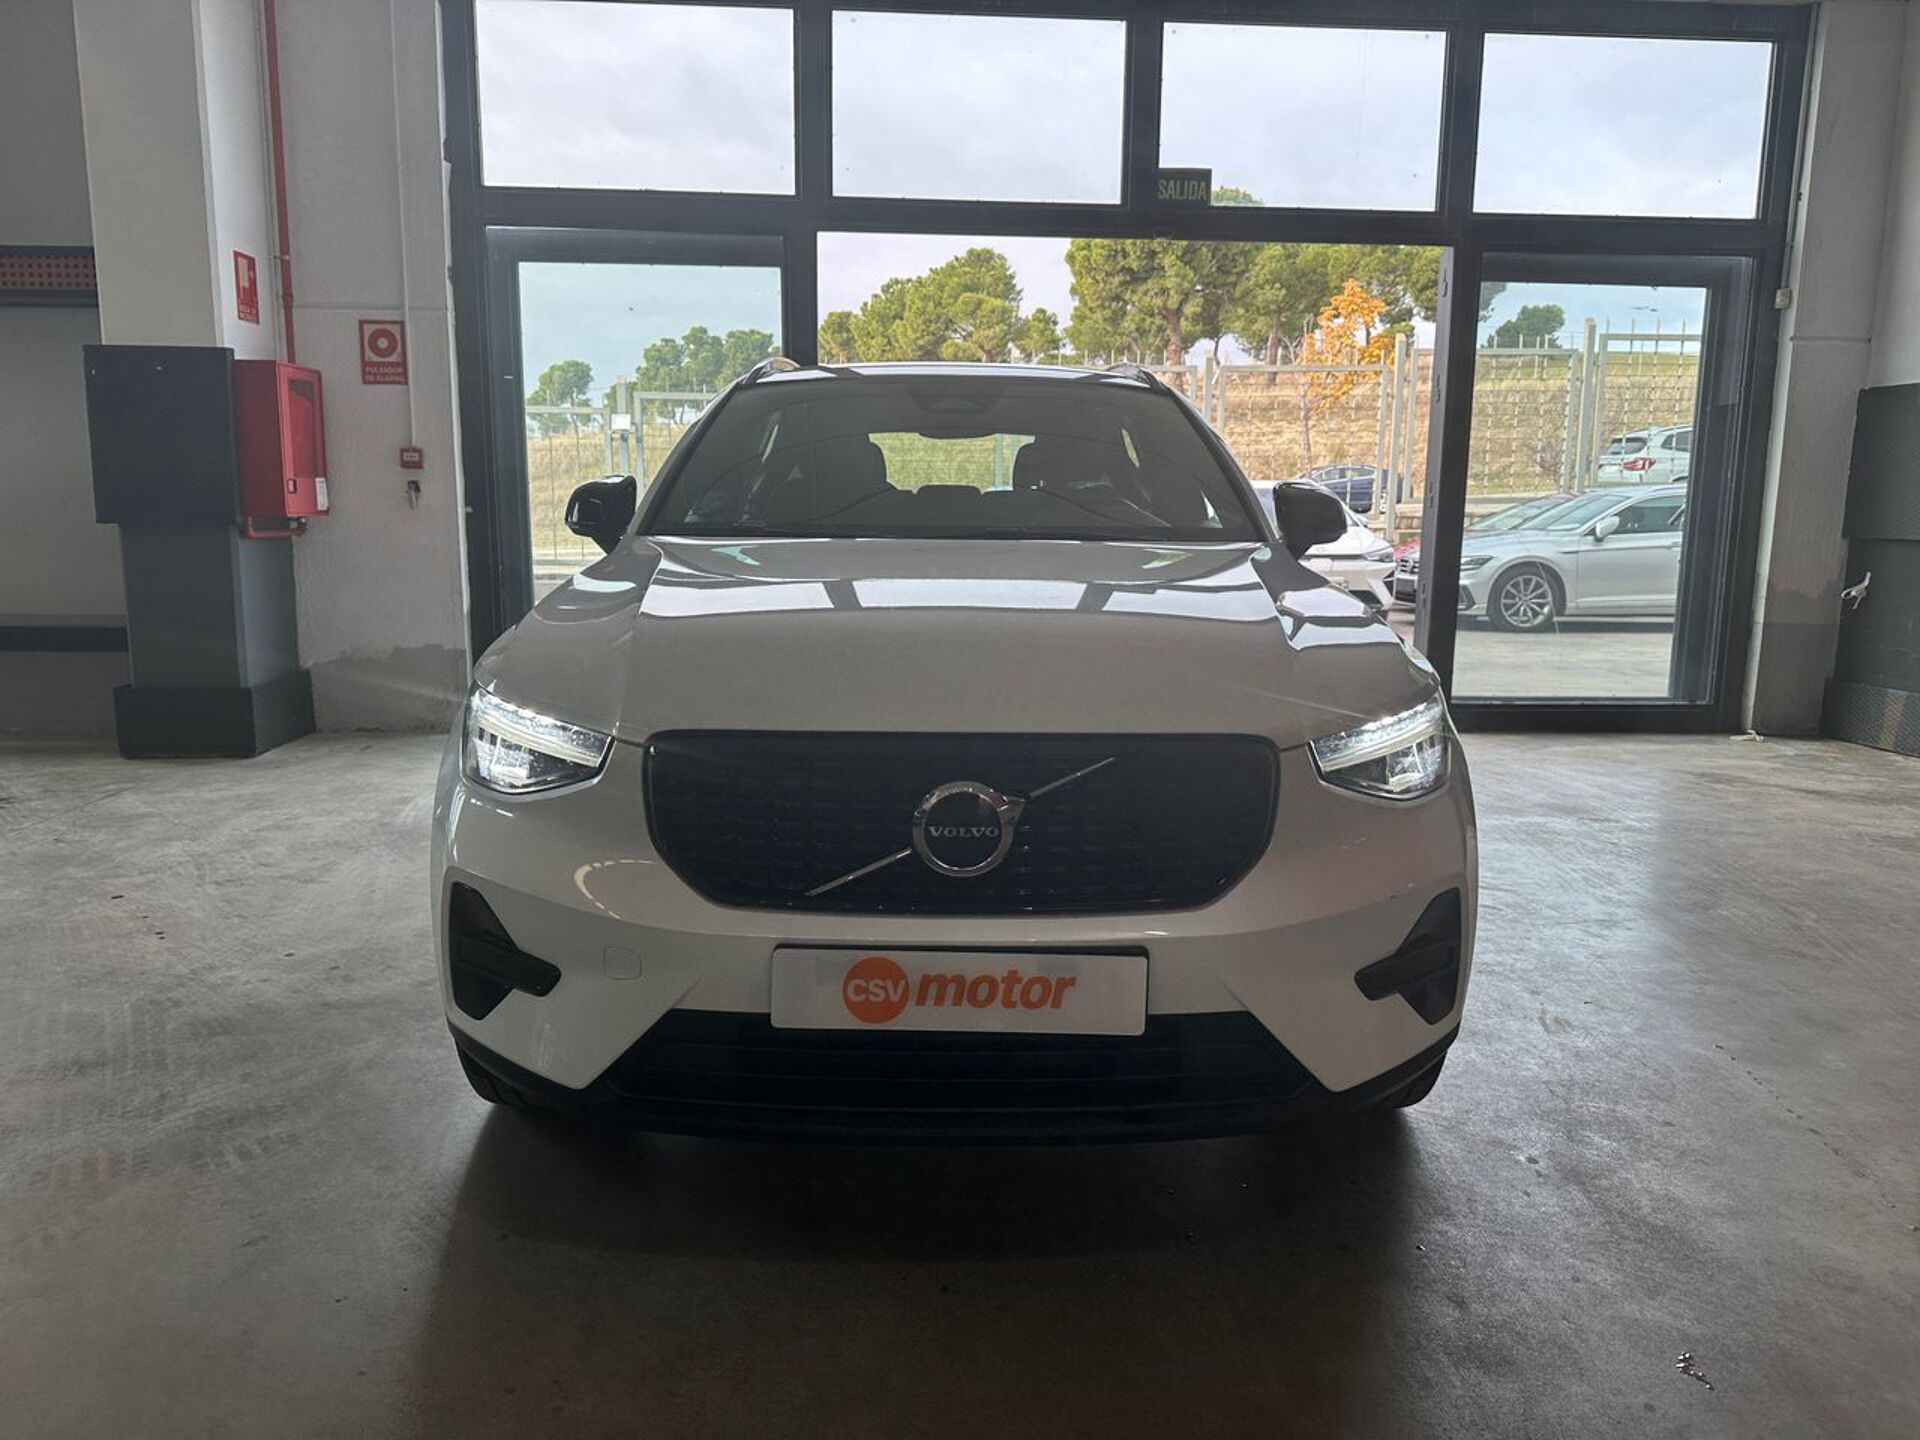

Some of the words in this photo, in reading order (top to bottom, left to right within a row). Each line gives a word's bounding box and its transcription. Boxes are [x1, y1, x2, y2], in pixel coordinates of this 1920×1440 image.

[1157, 180, 1207, 201] SALIDA
[928, 826, 999, 837] VOLVO
[915, 969, 1076, 1009] motor
